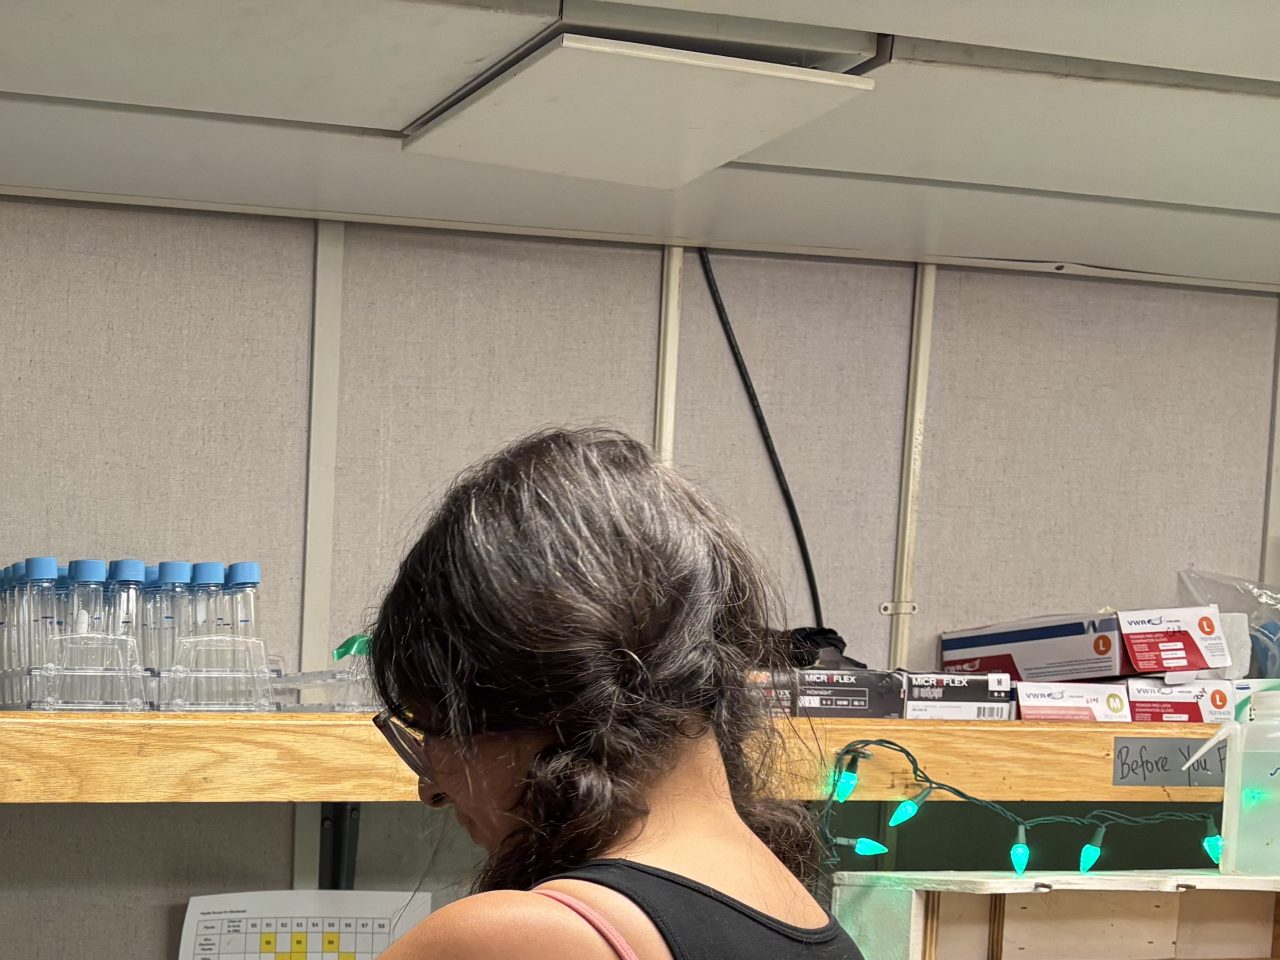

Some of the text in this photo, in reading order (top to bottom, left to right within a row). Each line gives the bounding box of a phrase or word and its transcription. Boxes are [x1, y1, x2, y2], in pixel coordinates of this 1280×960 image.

[1127, 619, 1147, 627] VWR
[1202, 621, 1211, 632] L
[1099, 640, 1106, 651] L
[1025, 691, 1046, 699] VWR
[1216, 696, 1223, 705] L
[1109, 698, 1120, 709] M
[1117, 744, 1170, 782] Before
[1178, 744, 1212, 787] You
